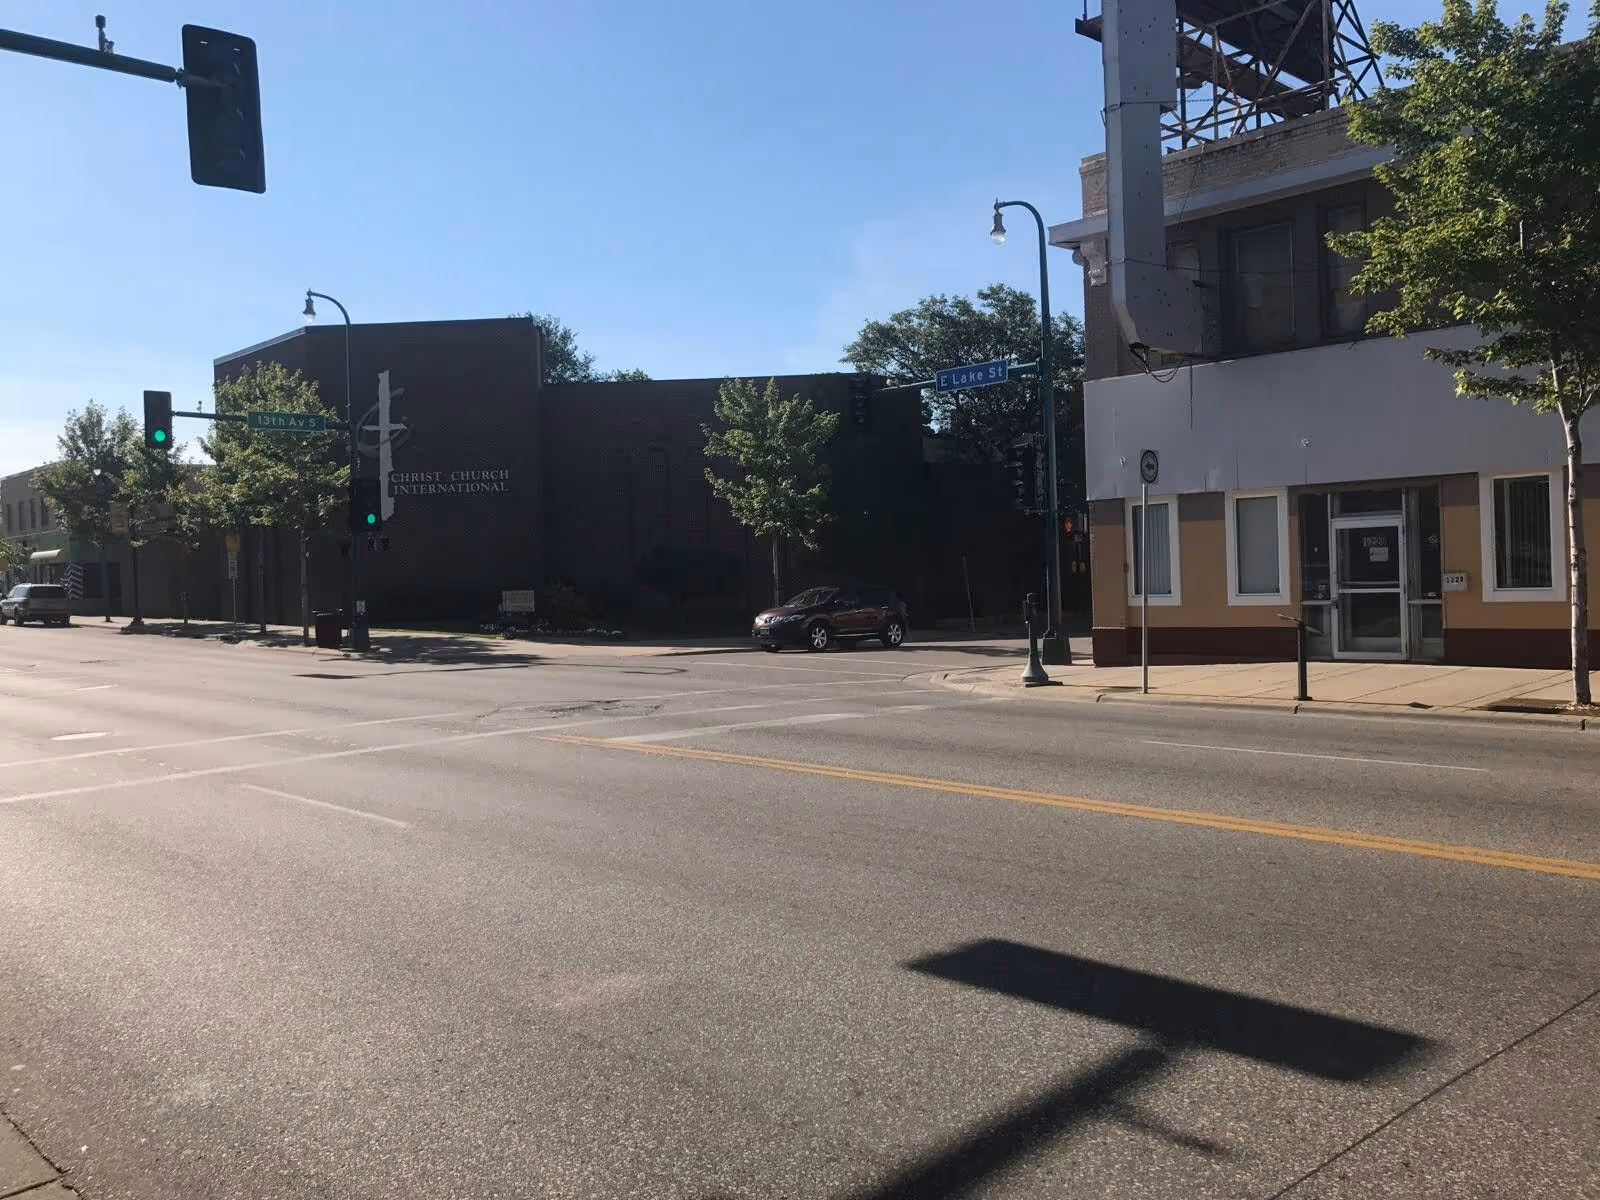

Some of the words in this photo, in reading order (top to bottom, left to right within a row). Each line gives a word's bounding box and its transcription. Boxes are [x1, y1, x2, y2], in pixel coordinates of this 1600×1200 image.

[940, 375, 948, 387] E
[952, 371, 984, 385] Lake
[988, 366, 1003, 378] St
[257, 415, 286, 426] 13th
[288, 416, 305, 427] Av
[308, 418, 317, 428] S
[391, 471, 442, 483] CHRIST
[450, 469, 509, 481] CHURCH
[394, 482, 508, 496] INTERNATIONAL
